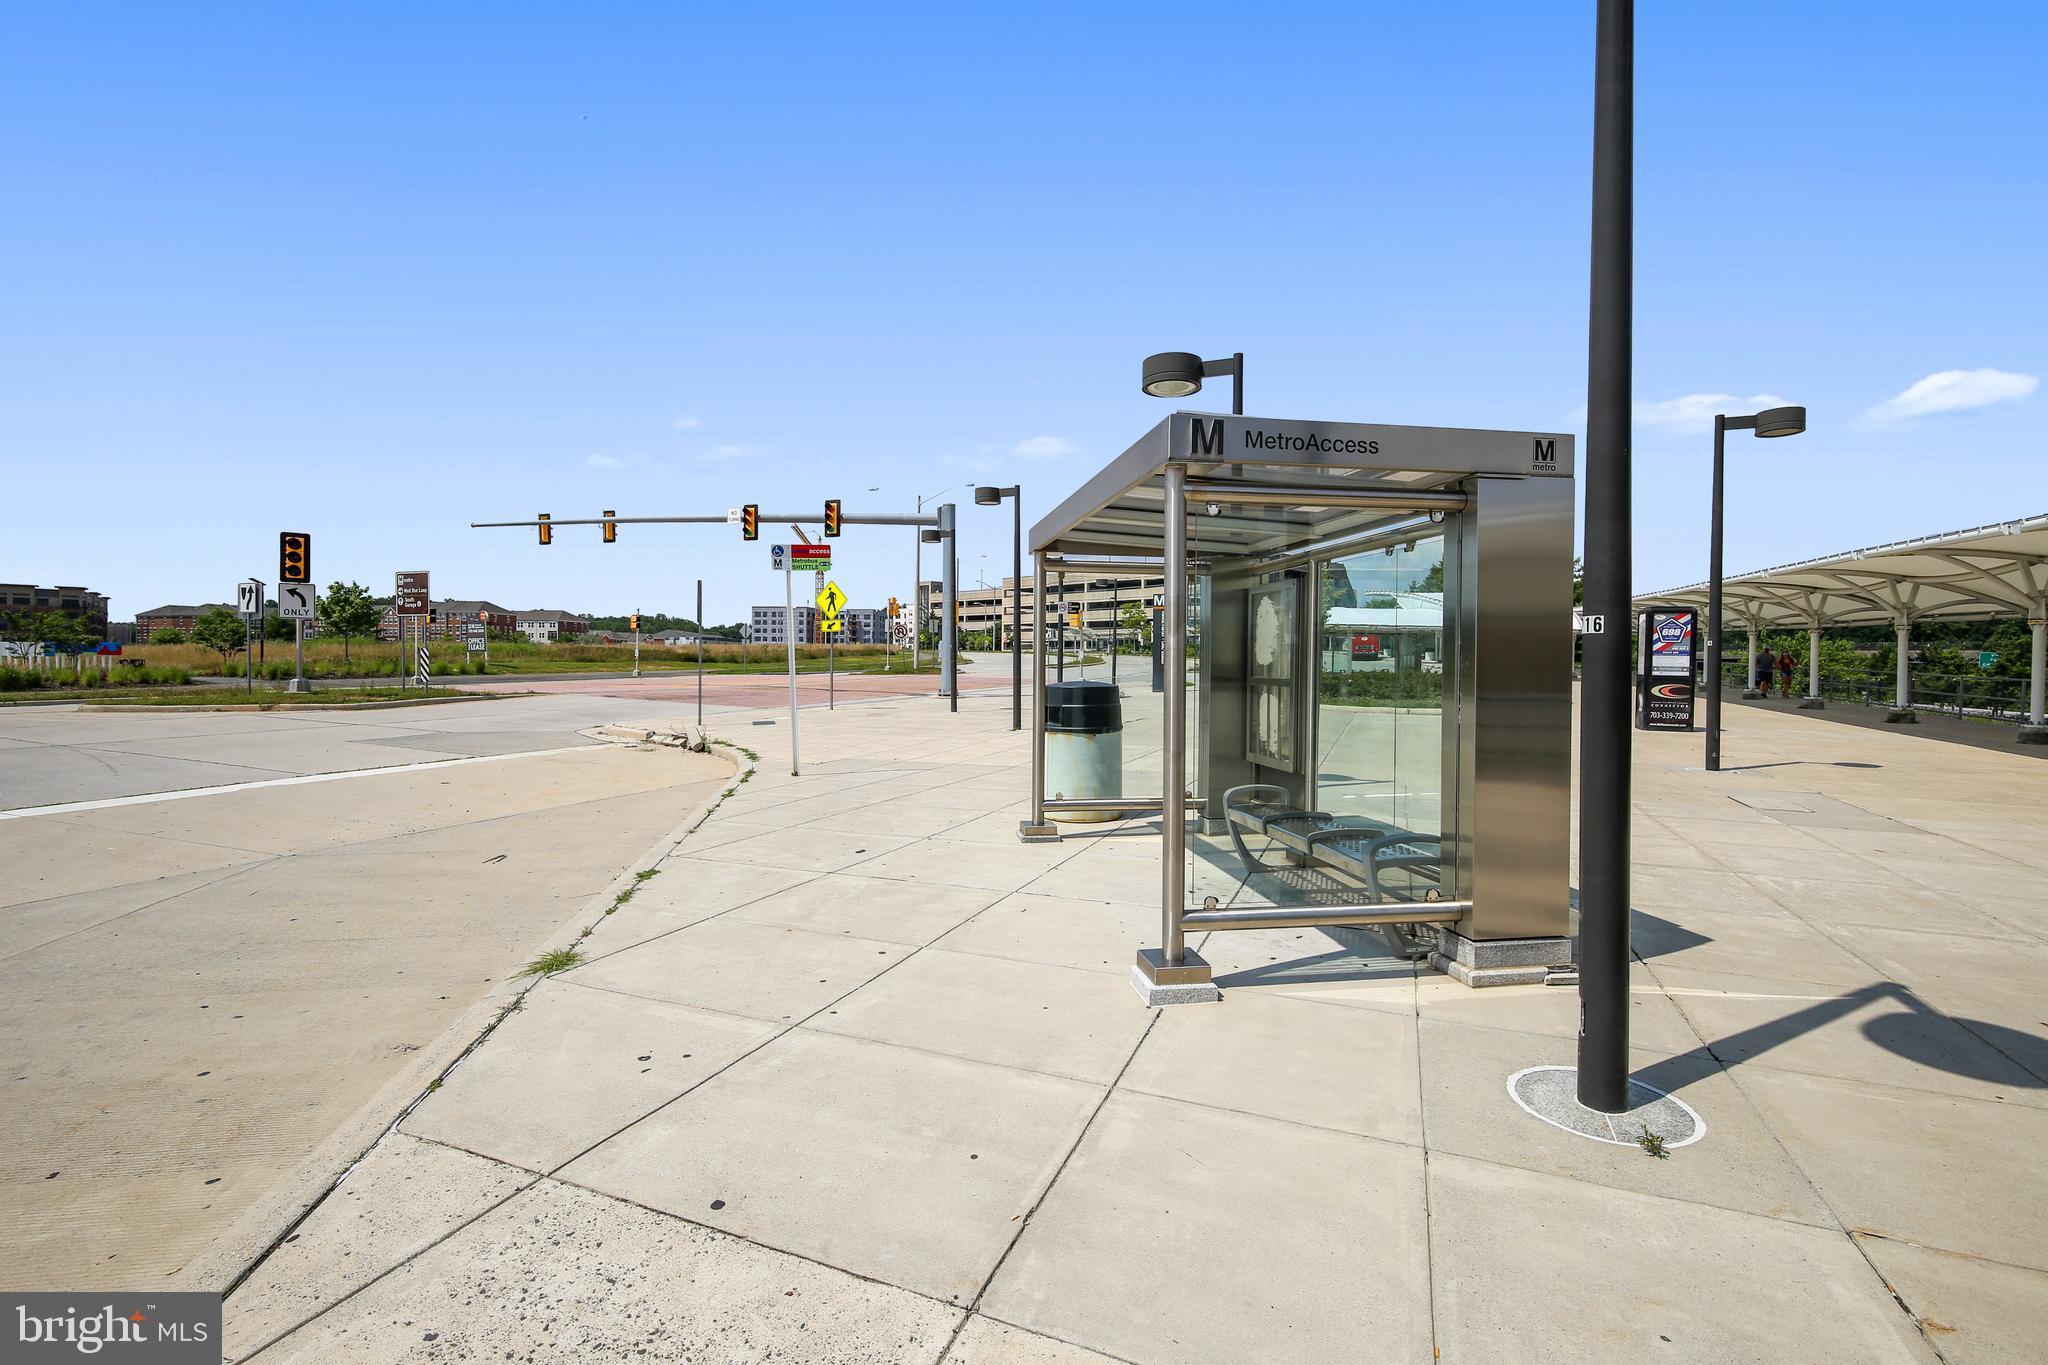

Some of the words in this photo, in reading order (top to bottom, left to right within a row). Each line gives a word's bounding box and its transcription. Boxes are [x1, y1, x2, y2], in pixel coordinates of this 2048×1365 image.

[1191, 418, 1225, 455] M
[1245, 430, 1379, 455] MetroAccess
[1534, 439, 1554, 462] M
[1586, 617, 1602, 632] 16
[1649, 711, 1690, 720] 703-339-7200
